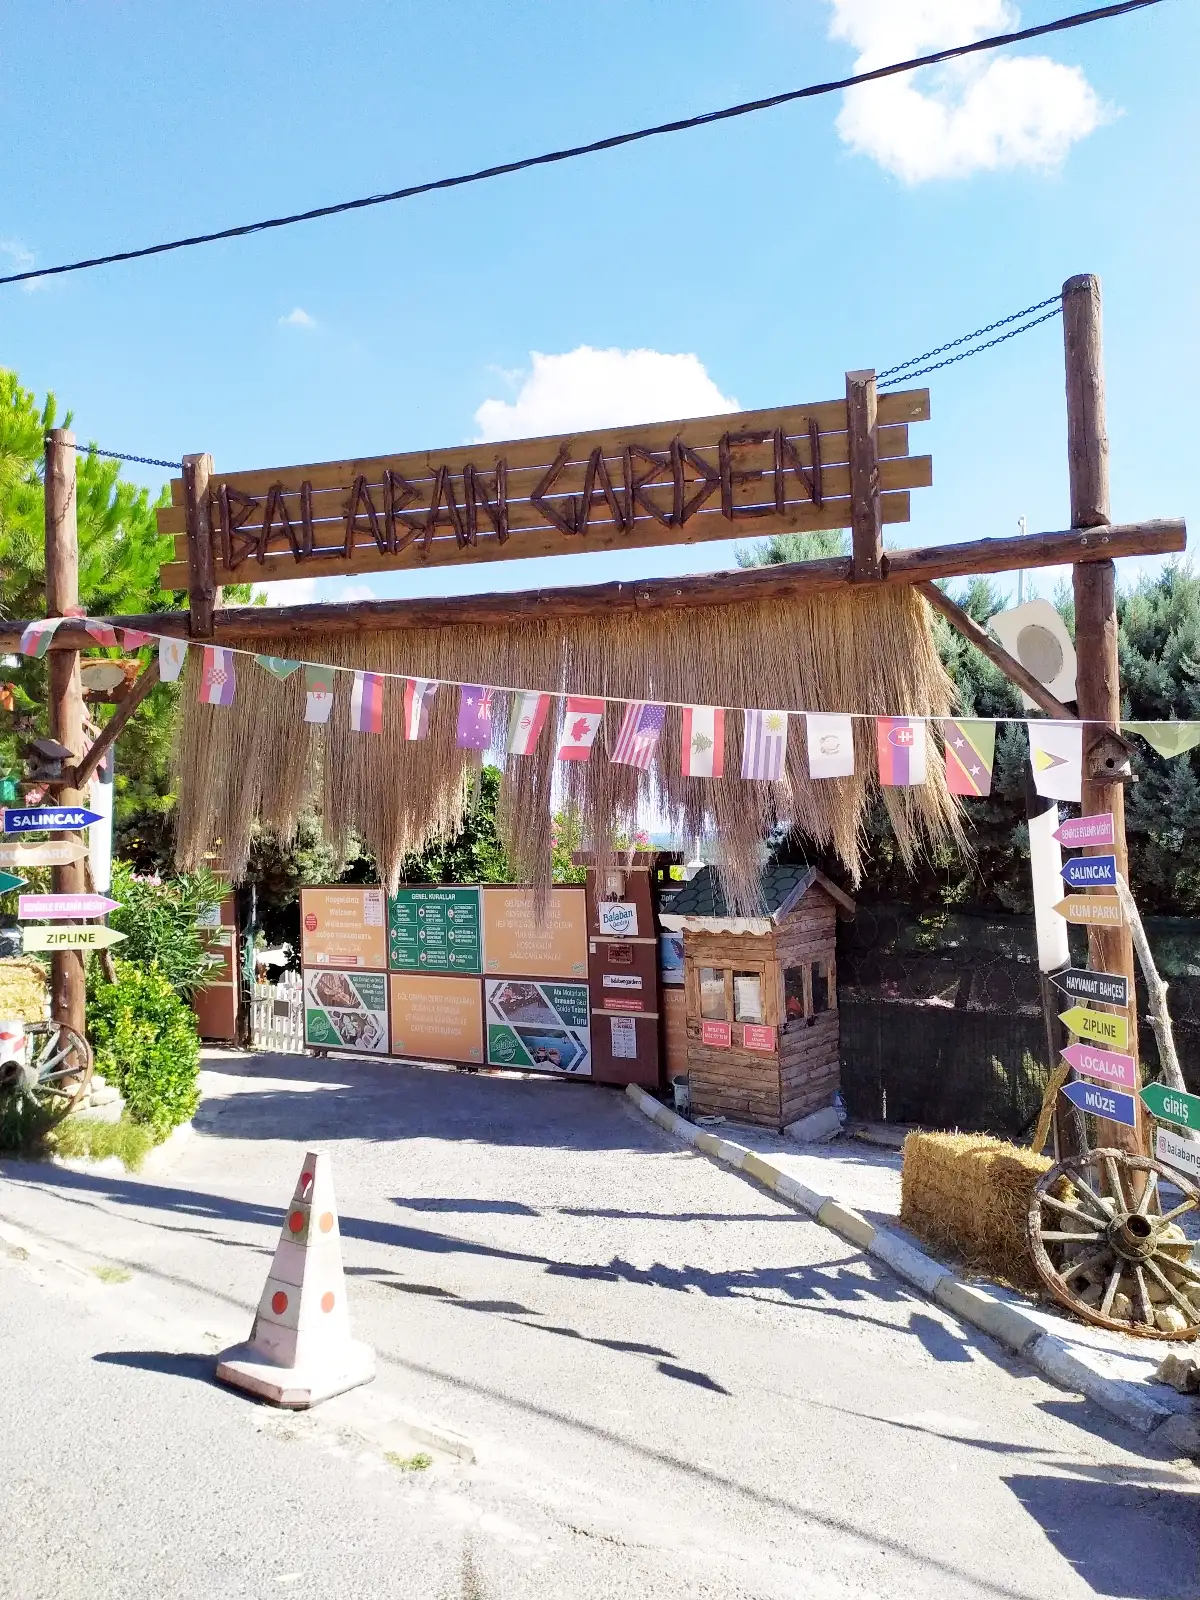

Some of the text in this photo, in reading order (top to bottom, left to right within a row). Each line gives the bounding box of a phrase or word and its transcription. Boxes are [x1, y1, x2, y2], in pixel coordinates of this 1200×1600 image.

[215, 418, 825, 571] BALABAN GARDEN
[13, 813, 85, 827] SALINCAK
[1070, 864, 1112, 880] SALINCAK
[329, 908, 357, 916] Welcome
[603, 909, 633, 924] Balaban
[1069, 904, 1118, 919] KUM PARKI
[46, 933, 96, 943] ZIPLINE
[1066, 976, 1124, 1001] HAYVANAT BAHÇESİ
[572, 1015, 587, 1025] Turu
[1083, 1017, 1117, 1038] ZIPLINE
[1080, 1054, 1125, 1079] LOCALAR
[1085, 1091, 1116, 1114] MÜZE
[1163, 1094, 1189, 1124] GİRİŞ
